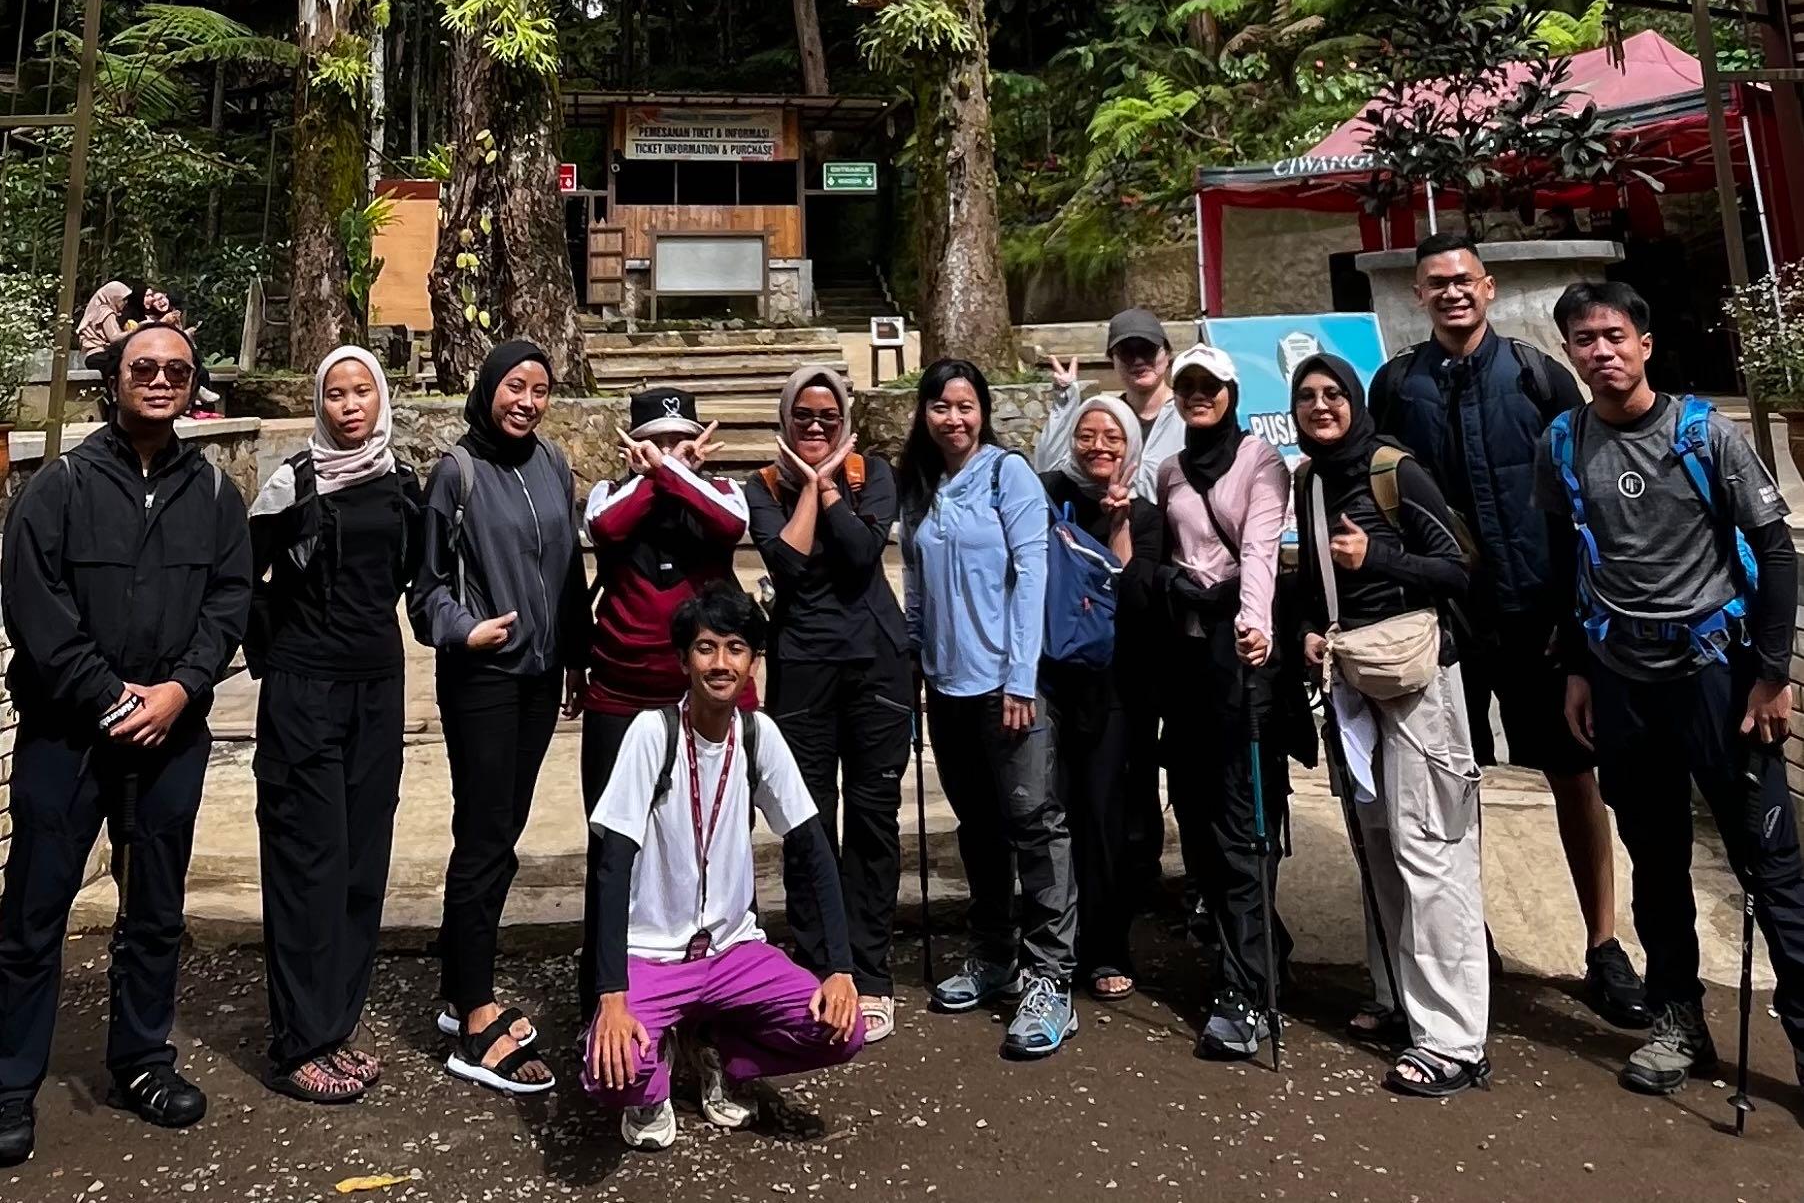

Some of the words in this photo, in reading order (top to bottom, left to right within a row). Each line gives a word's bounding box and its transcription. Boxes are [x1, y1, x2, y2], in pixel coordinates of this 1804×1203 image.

[692, 127, 714, 138] TIKET
[725, 128, 770, 139] INFORMASI
[635, 143, 663, 154] TICKET
[665, 144, 719, 155] INFORMATION
[722, 145, 728, 154] &
[731, 145, 774, 156] PURCHASE
